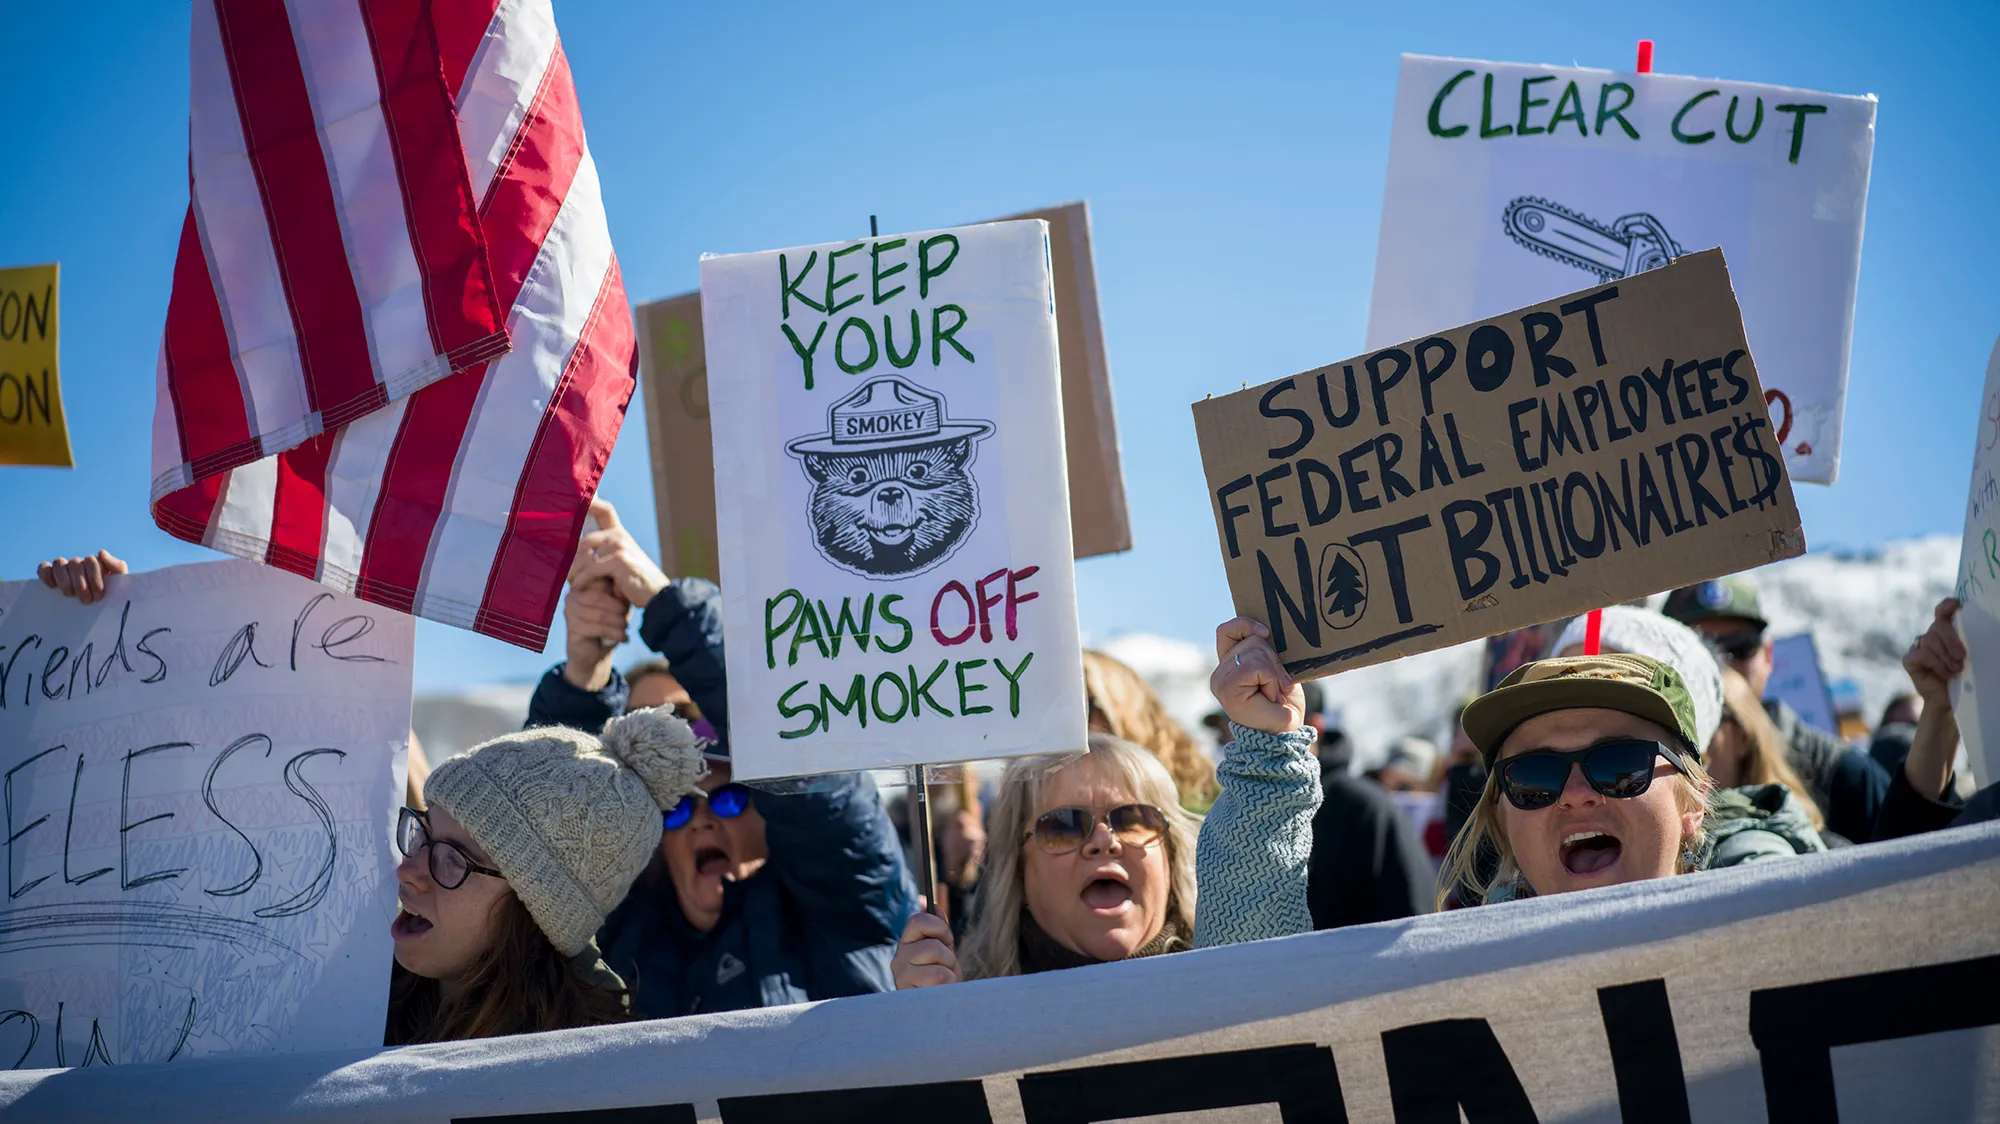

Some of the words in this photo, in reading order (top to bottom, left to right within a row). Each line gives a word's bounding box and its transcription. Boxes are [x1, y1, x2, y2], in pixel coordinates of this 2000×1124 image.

[1427, 70, 1641, 140] CLEAR
[1670, 90, 1828, 165] CUT
[778, 233, 960, 319] KEEP
[780, 303, 975, 390] YOUR
[1259, 287, 1619, 459] SUPPORT
[846, 411, 925, 436] SMOKEY
[1216, 412, 1485, 559] FEDERAL
[1508, 349, 1750, 472] EMPLOYEES
[765, 588, 913, 669] PAWS
[930, 566, 1040, 646] OFF
[1257, 515, 1431, 653] NOT
[208, 593, 400, 687] are
[777, 652, 1034, 739] SMOKEY
